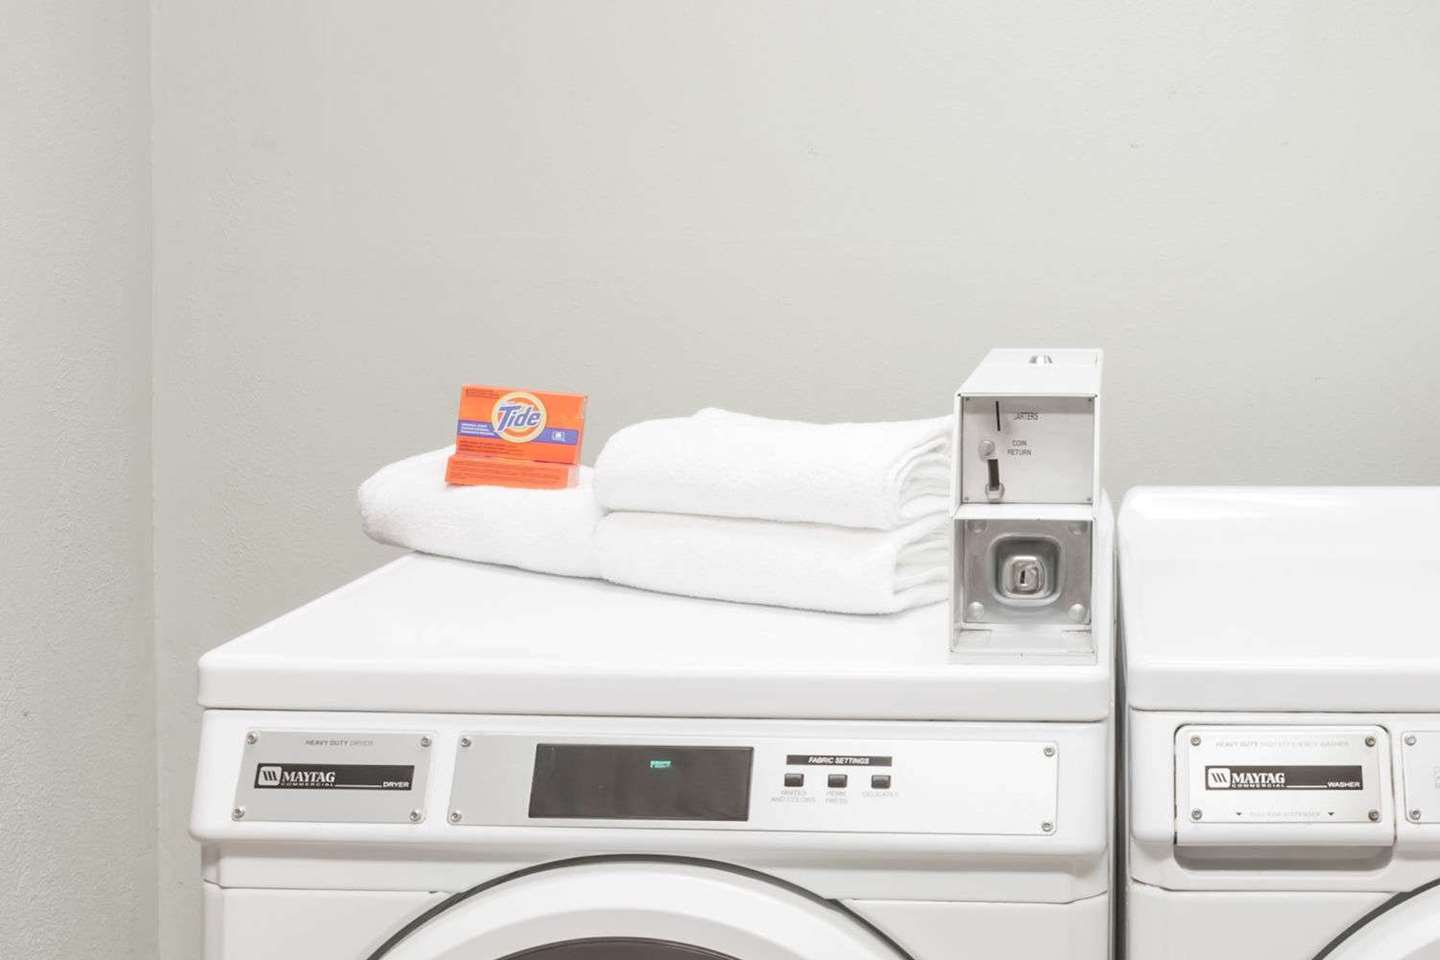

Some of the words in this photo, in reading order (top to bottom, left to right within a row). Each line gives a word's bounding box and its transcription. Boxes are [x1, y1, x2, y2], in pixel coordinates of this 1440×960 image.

[495, 403, 541, 433] Tide
[808, 755, 834, 764] FABRIC
[835, 756, 870, 766] SETTINGS
[281, 771, 336, 782] MAYTAG
[1231, 772, 1286, 784] MAYTAG
